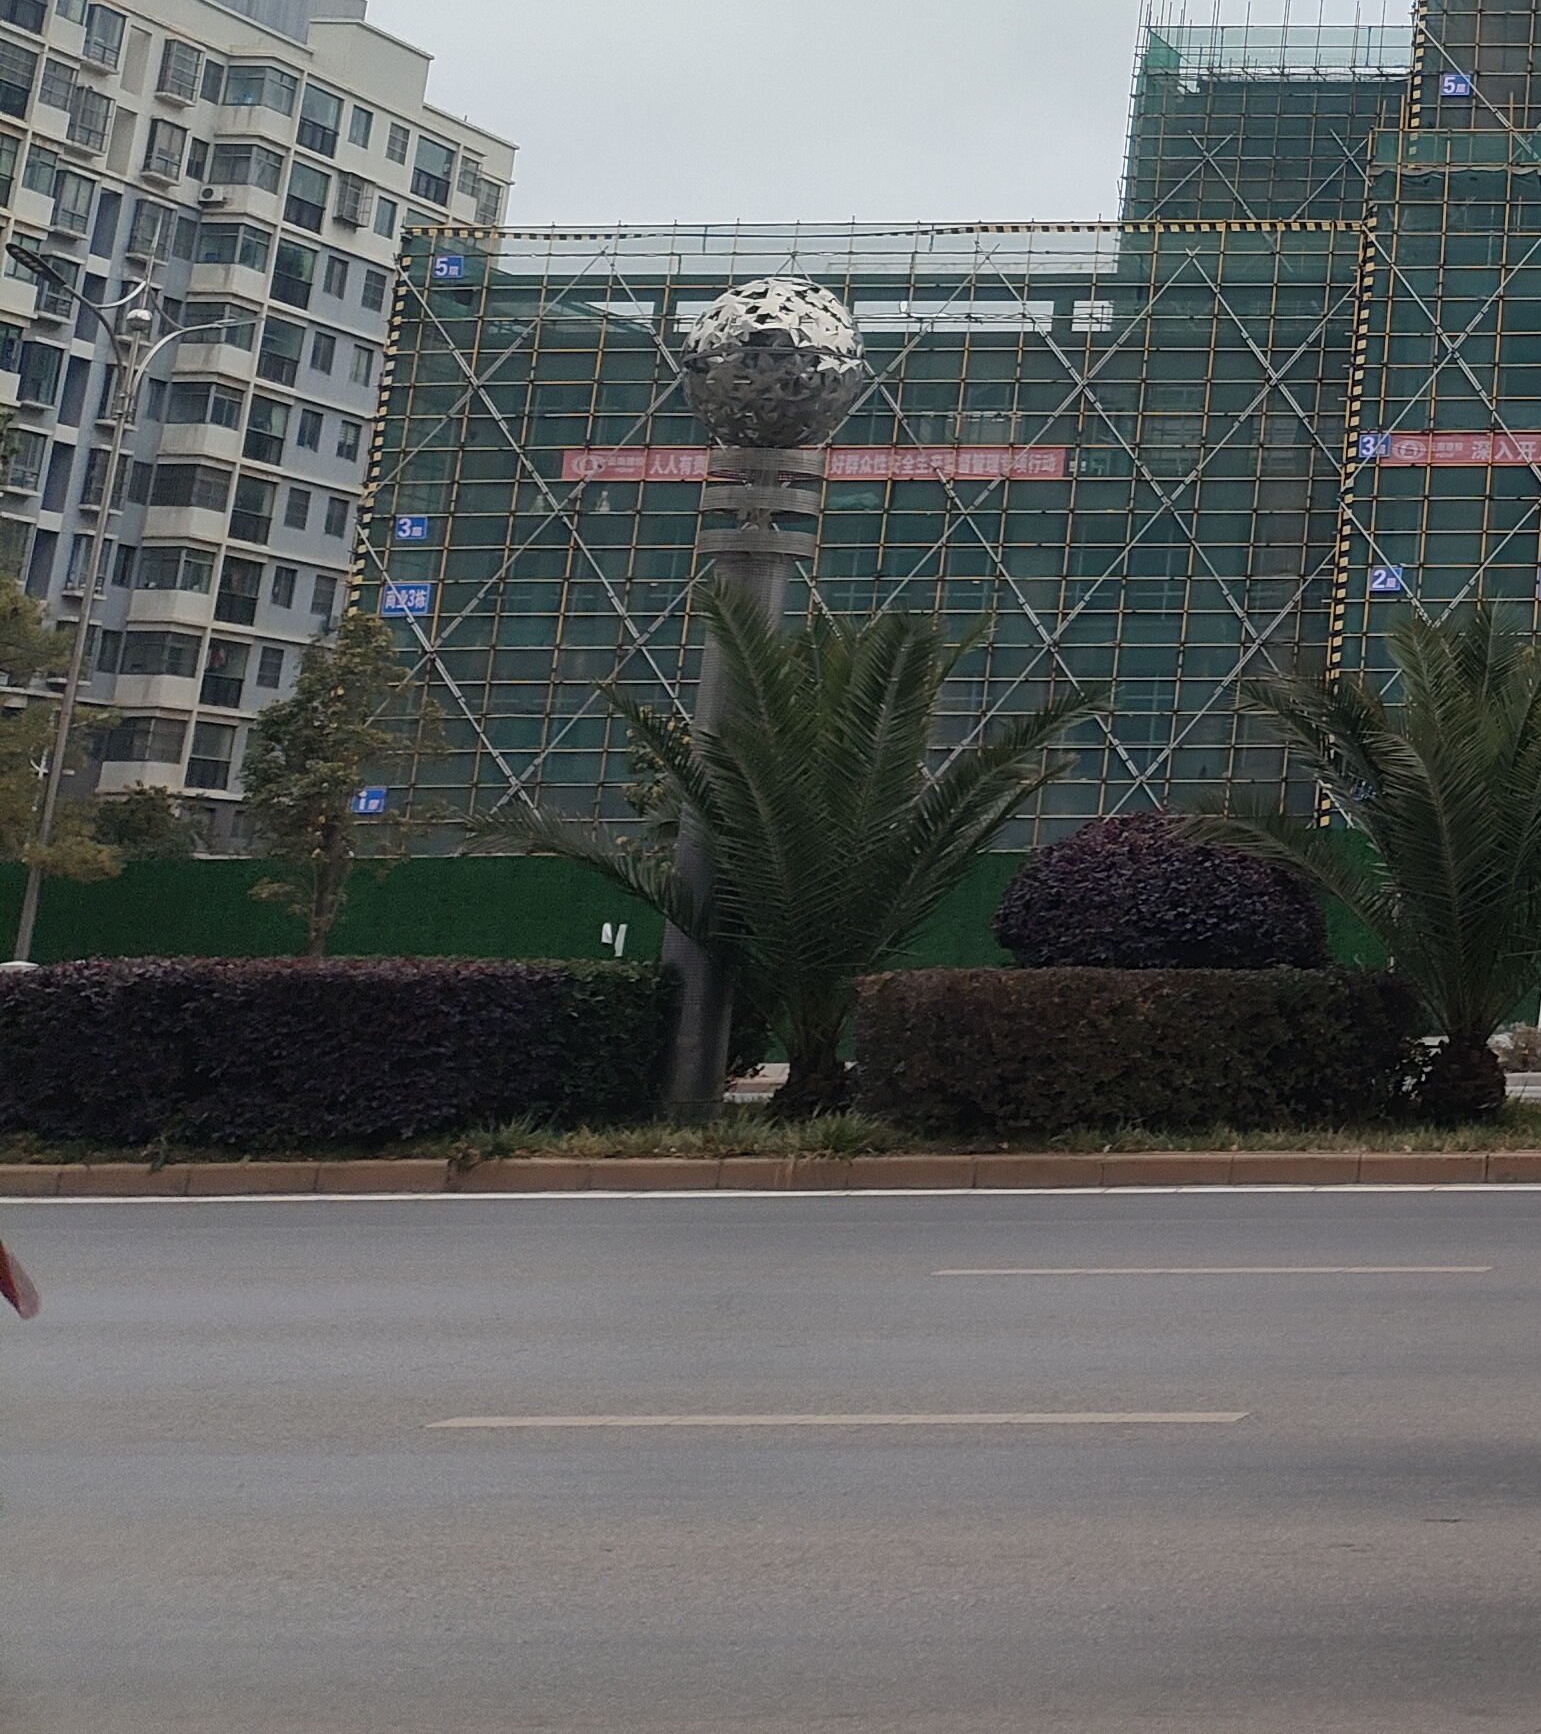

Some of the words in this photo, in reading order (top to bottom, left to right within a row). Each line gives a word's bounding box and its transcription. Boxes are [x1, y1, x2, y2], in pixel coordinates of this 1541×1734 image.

[1443, 77, 1465, 93] 5层
[435, 258, 459, 276] 5层
[397, 518, 422, 537] 3层
[1371, 570, 1395, 588] 2层
